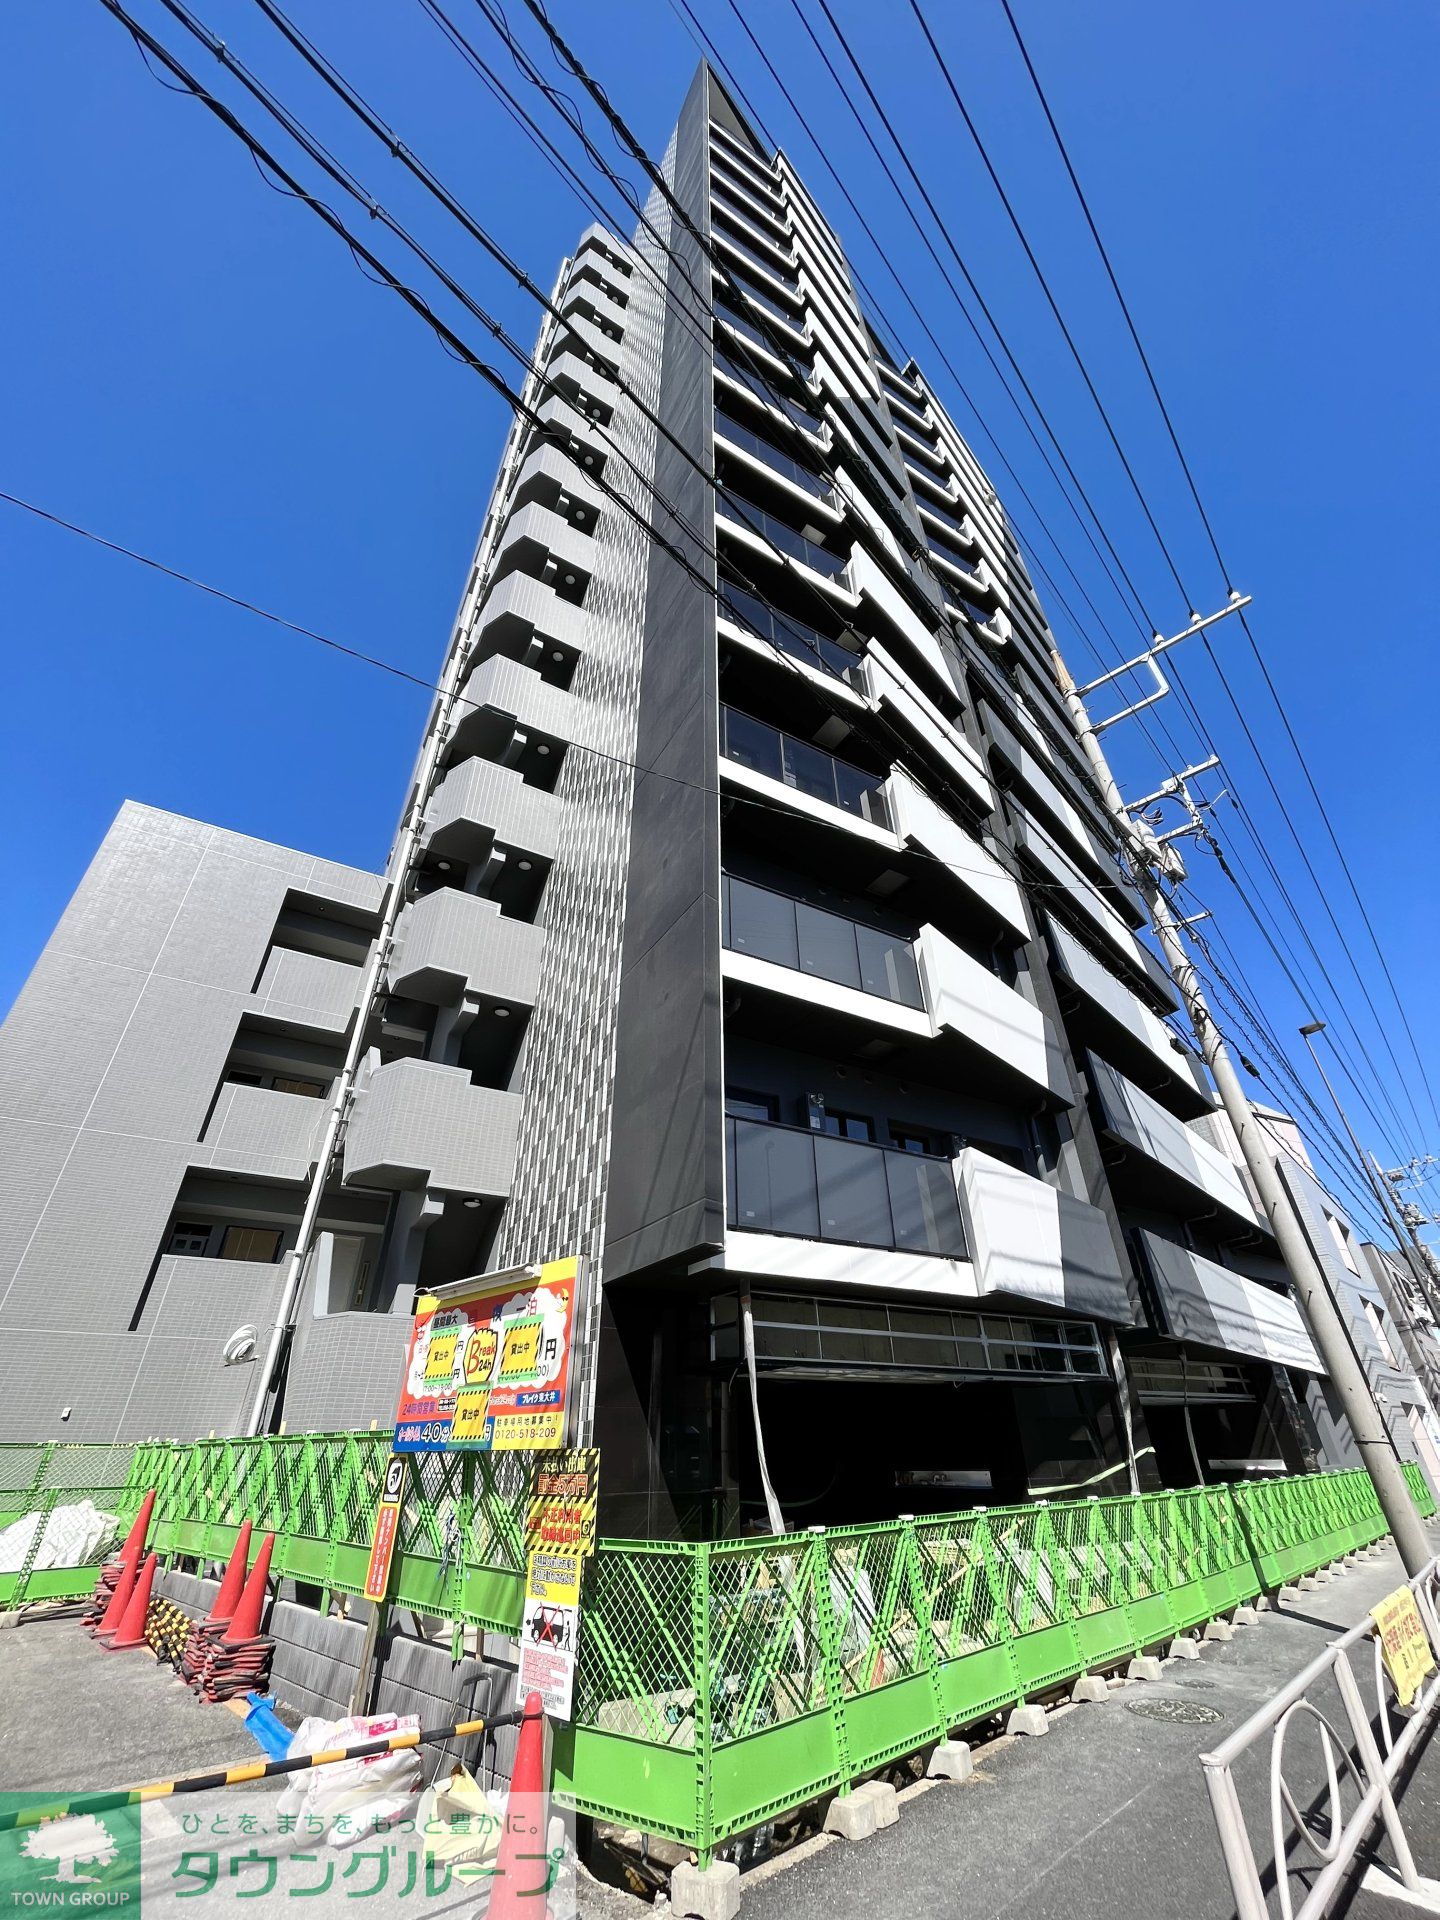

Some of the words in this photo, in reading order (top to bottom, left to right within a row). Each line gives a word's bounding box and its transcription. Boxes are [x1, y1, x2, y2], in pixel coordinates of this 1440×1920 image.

[433, 1350, 449, 1361] 貸出中
[510, 1342, 530, 1356] 貸出中
[544, 1338, 557, 1360] 円
[467, 1339, 495, 1376] Break
[478, 1357, 492, 1372] 24h
[461, 1409, 480, 1421] 貸出中
[494, 1427, 557, 1440] 0120-518-209
